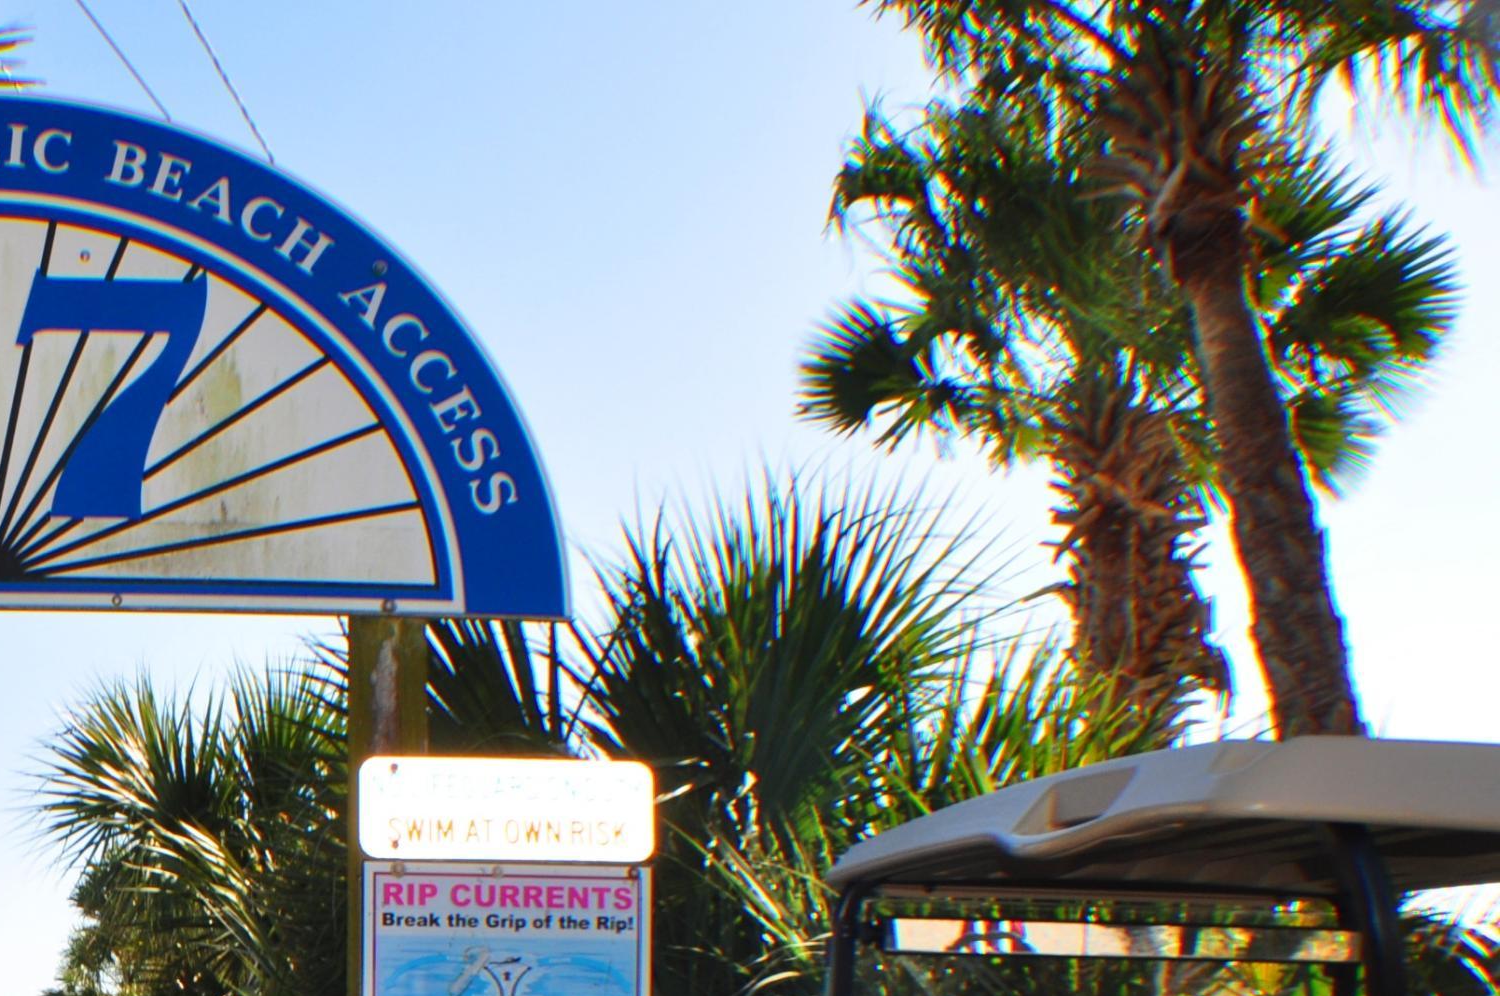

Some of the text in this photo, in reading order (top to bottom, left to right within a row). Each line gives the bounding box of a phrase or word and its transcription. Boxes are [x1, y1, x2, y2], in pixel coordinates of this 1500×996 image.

[104, 139, 335, 277] BEACH
[337, 279, 518, 516] ACCESS
[387, 817, 626, 846] SWIM AT OWN RISK
[381, 882, 634, 910] RIP CURRENTS
[381, 912, 635, 934] Break the Grip of the Rip!
